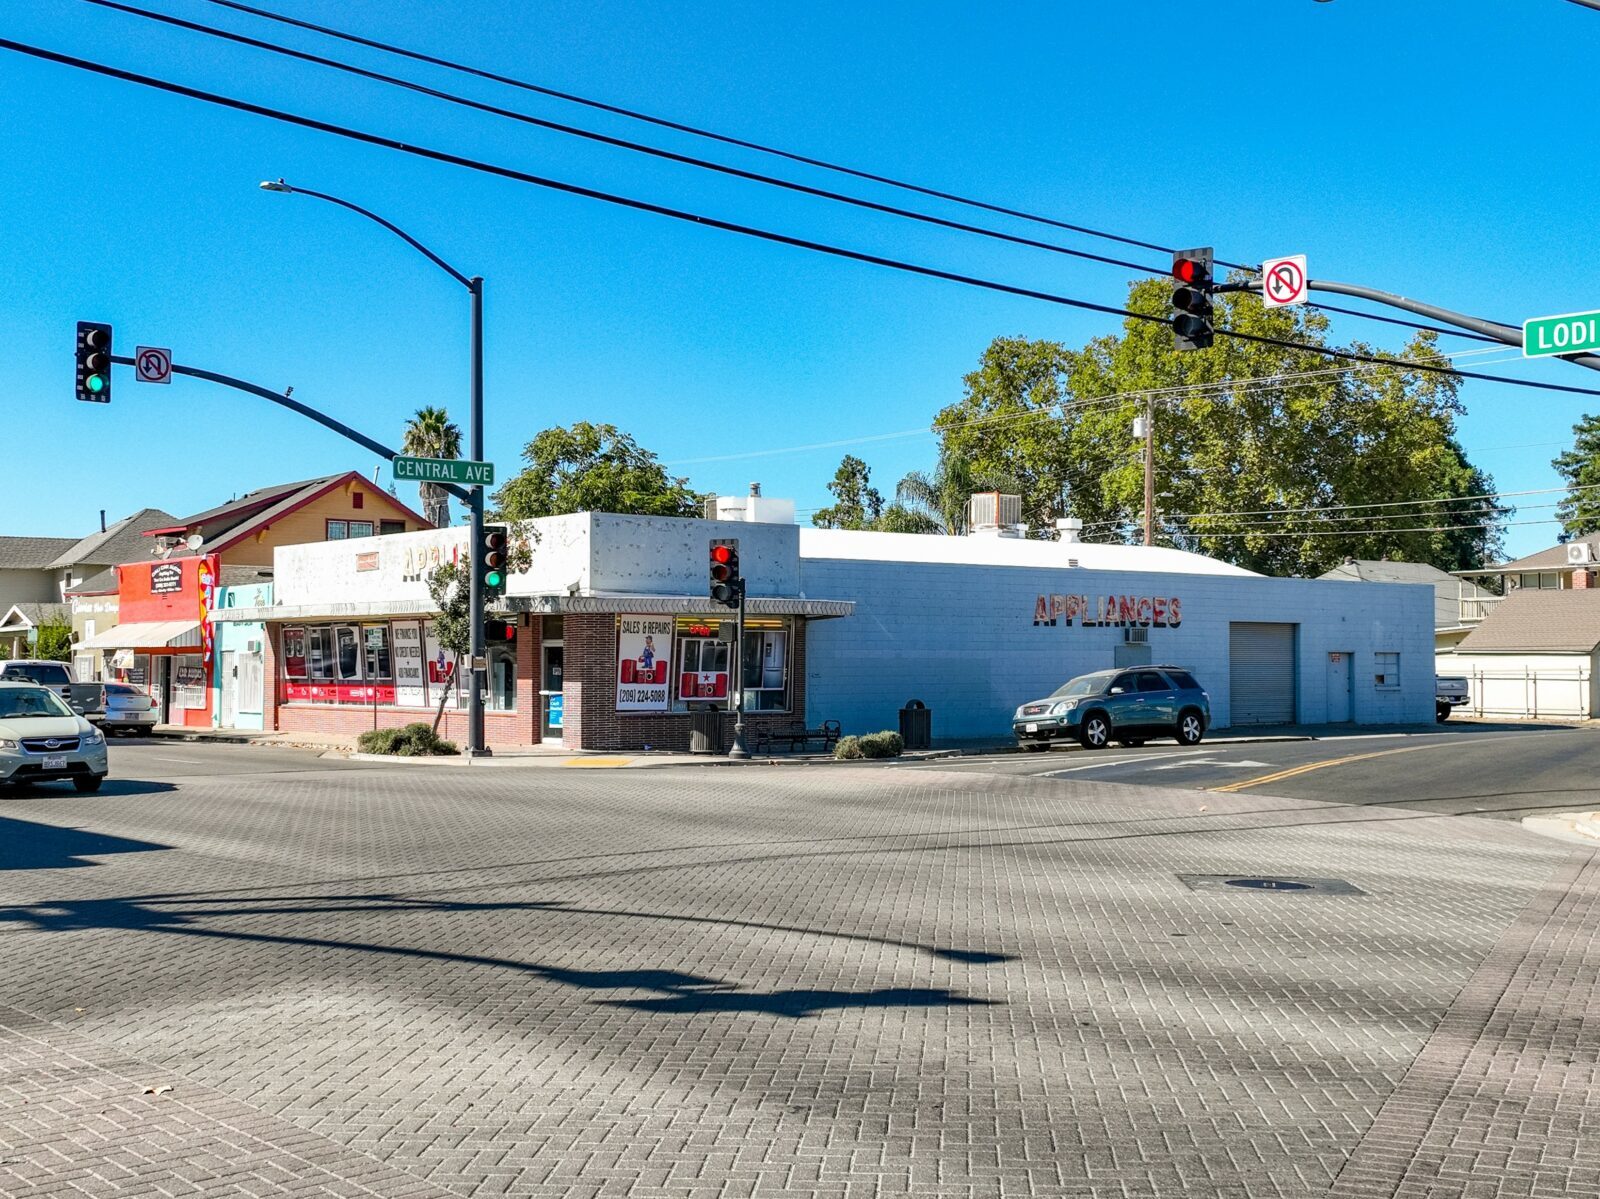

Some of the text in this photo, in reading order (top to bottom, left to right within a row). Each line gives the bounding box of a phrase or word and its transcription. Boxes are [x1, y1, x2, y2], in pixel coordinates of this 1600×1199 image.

[1538, 319, 1596, 349] LODI
[397, 460, 491, 481] CENTRAL AVE
[1033, 594, 1182, 629] APPLIANCES
[622, 620, 671, 635] SALES & REPAIRS
[688, 624, 711, 637] OPEN
[619, 688, 666, 703] (209) 224-5088
